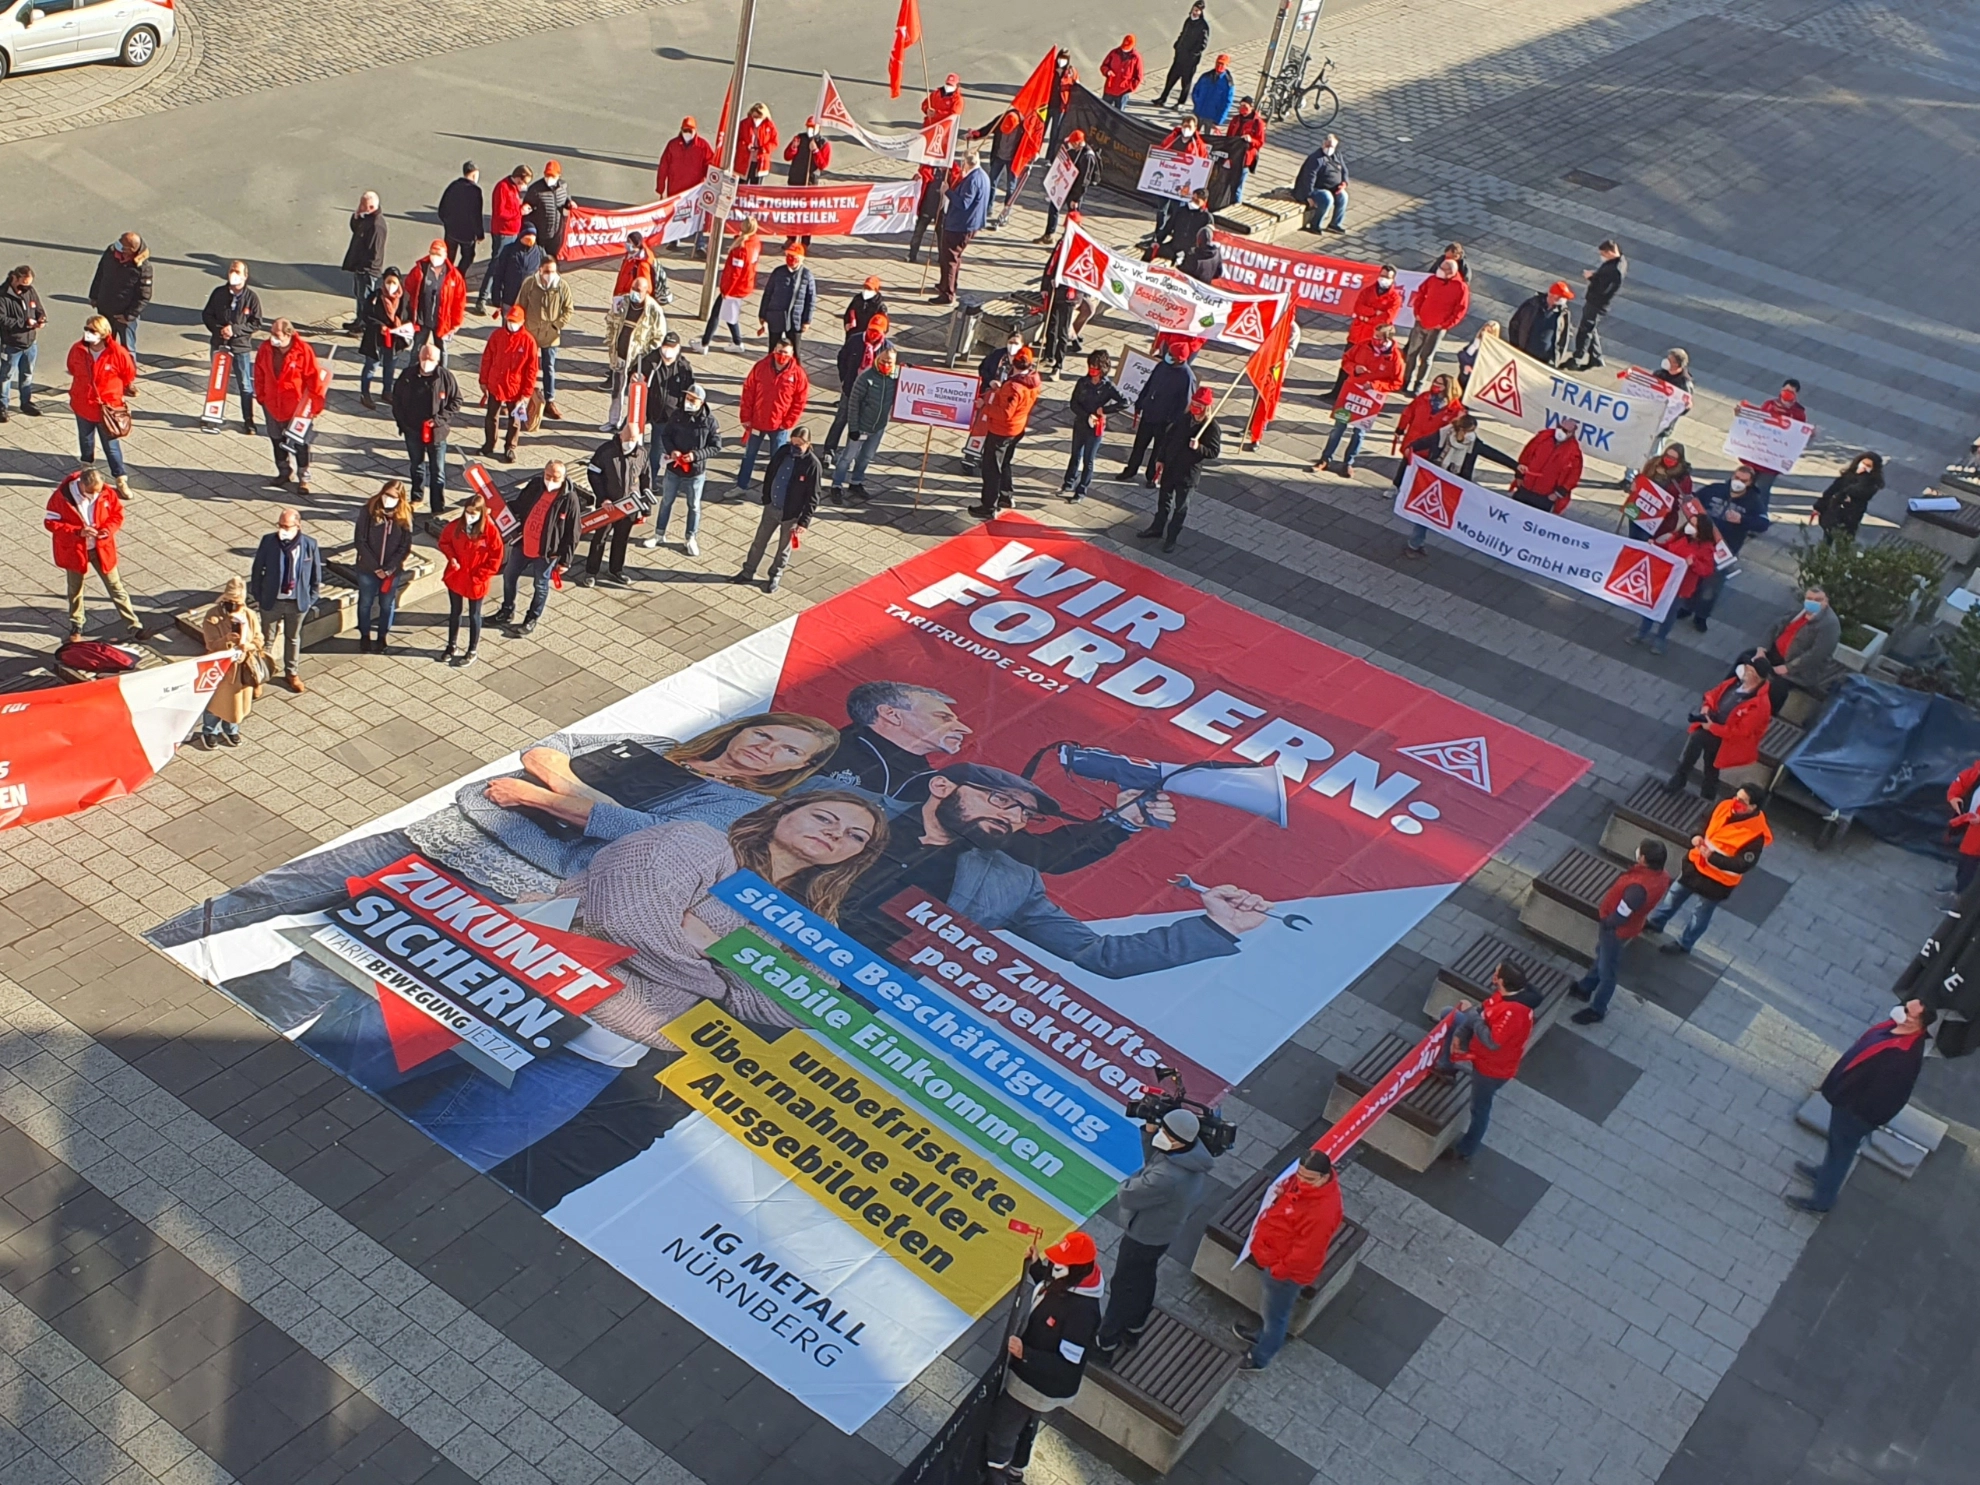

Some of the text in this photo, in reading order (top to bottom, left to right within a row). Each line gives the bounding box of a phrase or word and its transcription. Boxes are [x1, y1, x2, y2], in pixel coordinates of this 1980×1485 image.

[772, 211, 840, 224] VERTEILEN.
[809, 196, 859, 209] HALTEN.
[1112, 260, 1128, 273] Der
[1132, 267, 1143, 279] VK
[1220, 262, 1343, 305] NUR MIT UNS!
[1293, 262, 1338, 284] GIBT
[1339, 272, 1364, 290] ES
[900, 380, 926, 396] WIR
[935, 386, 973, 398] STANDORT
[1344, 402, 1369, 416] GELD
[1548, 375, 1630, 421] TRAFO
[1456, 520, 1604, 583] Mobility GmbH NBG
[1487, 505, 1591, 550] VK Siemens
[976, 540, 1186, 650] WIR
[884, 603, 1070, 694] TARIFRUNDE 2021
[907, 571, 1441, 835] FORDERN:
[336, 895, 565, 1049] SICHERN.
[378, 861, 612, 1001] ZUKUNFT
[905, 900, 998, 966] klare
[464, 1024, 525, 1061] JETZT
[733, 884, 1111, 1144] sichere Beschäftigung
[909, 945, 1147, 1101] perspektiven
[730, 945, 1065, 1178] stabile Einkommen
[687, 1072, 955, 1274] Ausgebildeten
[690, 1018, 991, 1243] Übernahme aller
[787, 1050, 1018, 1217] unbefristete
[661, 1236, 847, 1368] NÜRNBERG
[698, 1222, 870, 1347] IG METALL
